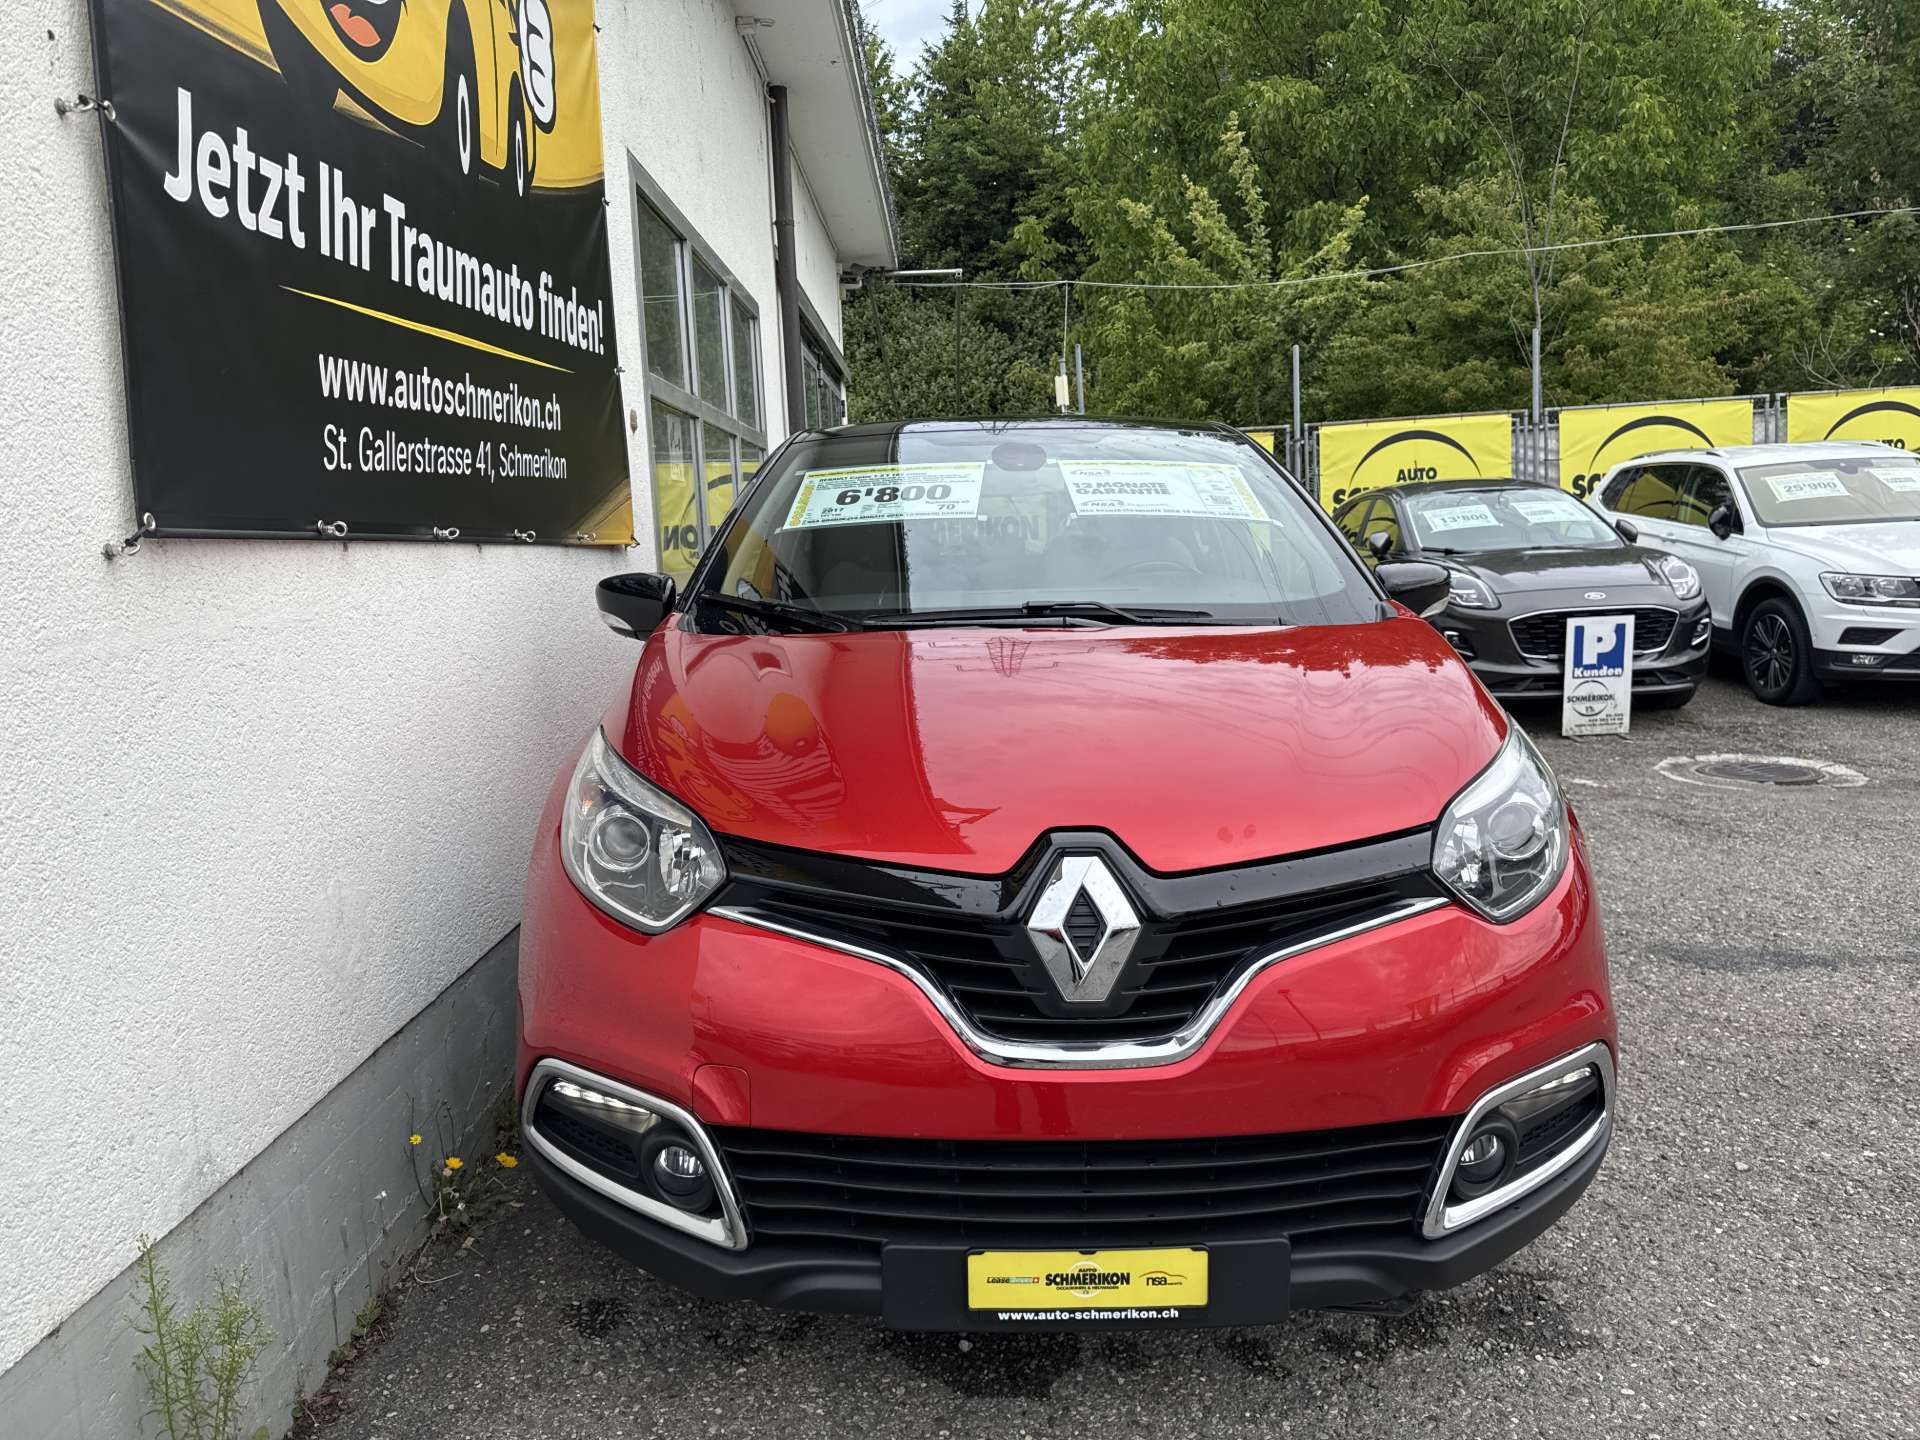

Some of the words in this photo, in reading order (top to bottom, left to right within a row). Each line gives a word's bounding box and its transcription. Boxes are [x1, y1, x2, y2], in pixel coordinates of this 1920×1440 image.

[164, 86, 305, 249] Jetzt
[319, 160, 376, 271] Ihr
[383, 192, 534, 331] Traumauto
[538, 270, 604, 355] finden!
[318, 353, 562, 431] www.autoschmerikon.ch
[323, 423, 352, 471] St.
[358, 426, 472, 475] Gallerstrasse
[475, 440, 495, 484] 41,
[499, 442, 567, 479] Schmerikon
[1396, 467, 1437, 482] AUTO
[835, 484, 952, 506] 6'800
[937, 503, 956, 511] 70
[1573, 664, 1622, 678] Kunden
[1045, 1272, 1131, 1286] SCHMERIKON
[1146, 1276, 1167, 1286] nsa
[998, 1308, 1179, 1321] www.auto-schmerikon.ch
